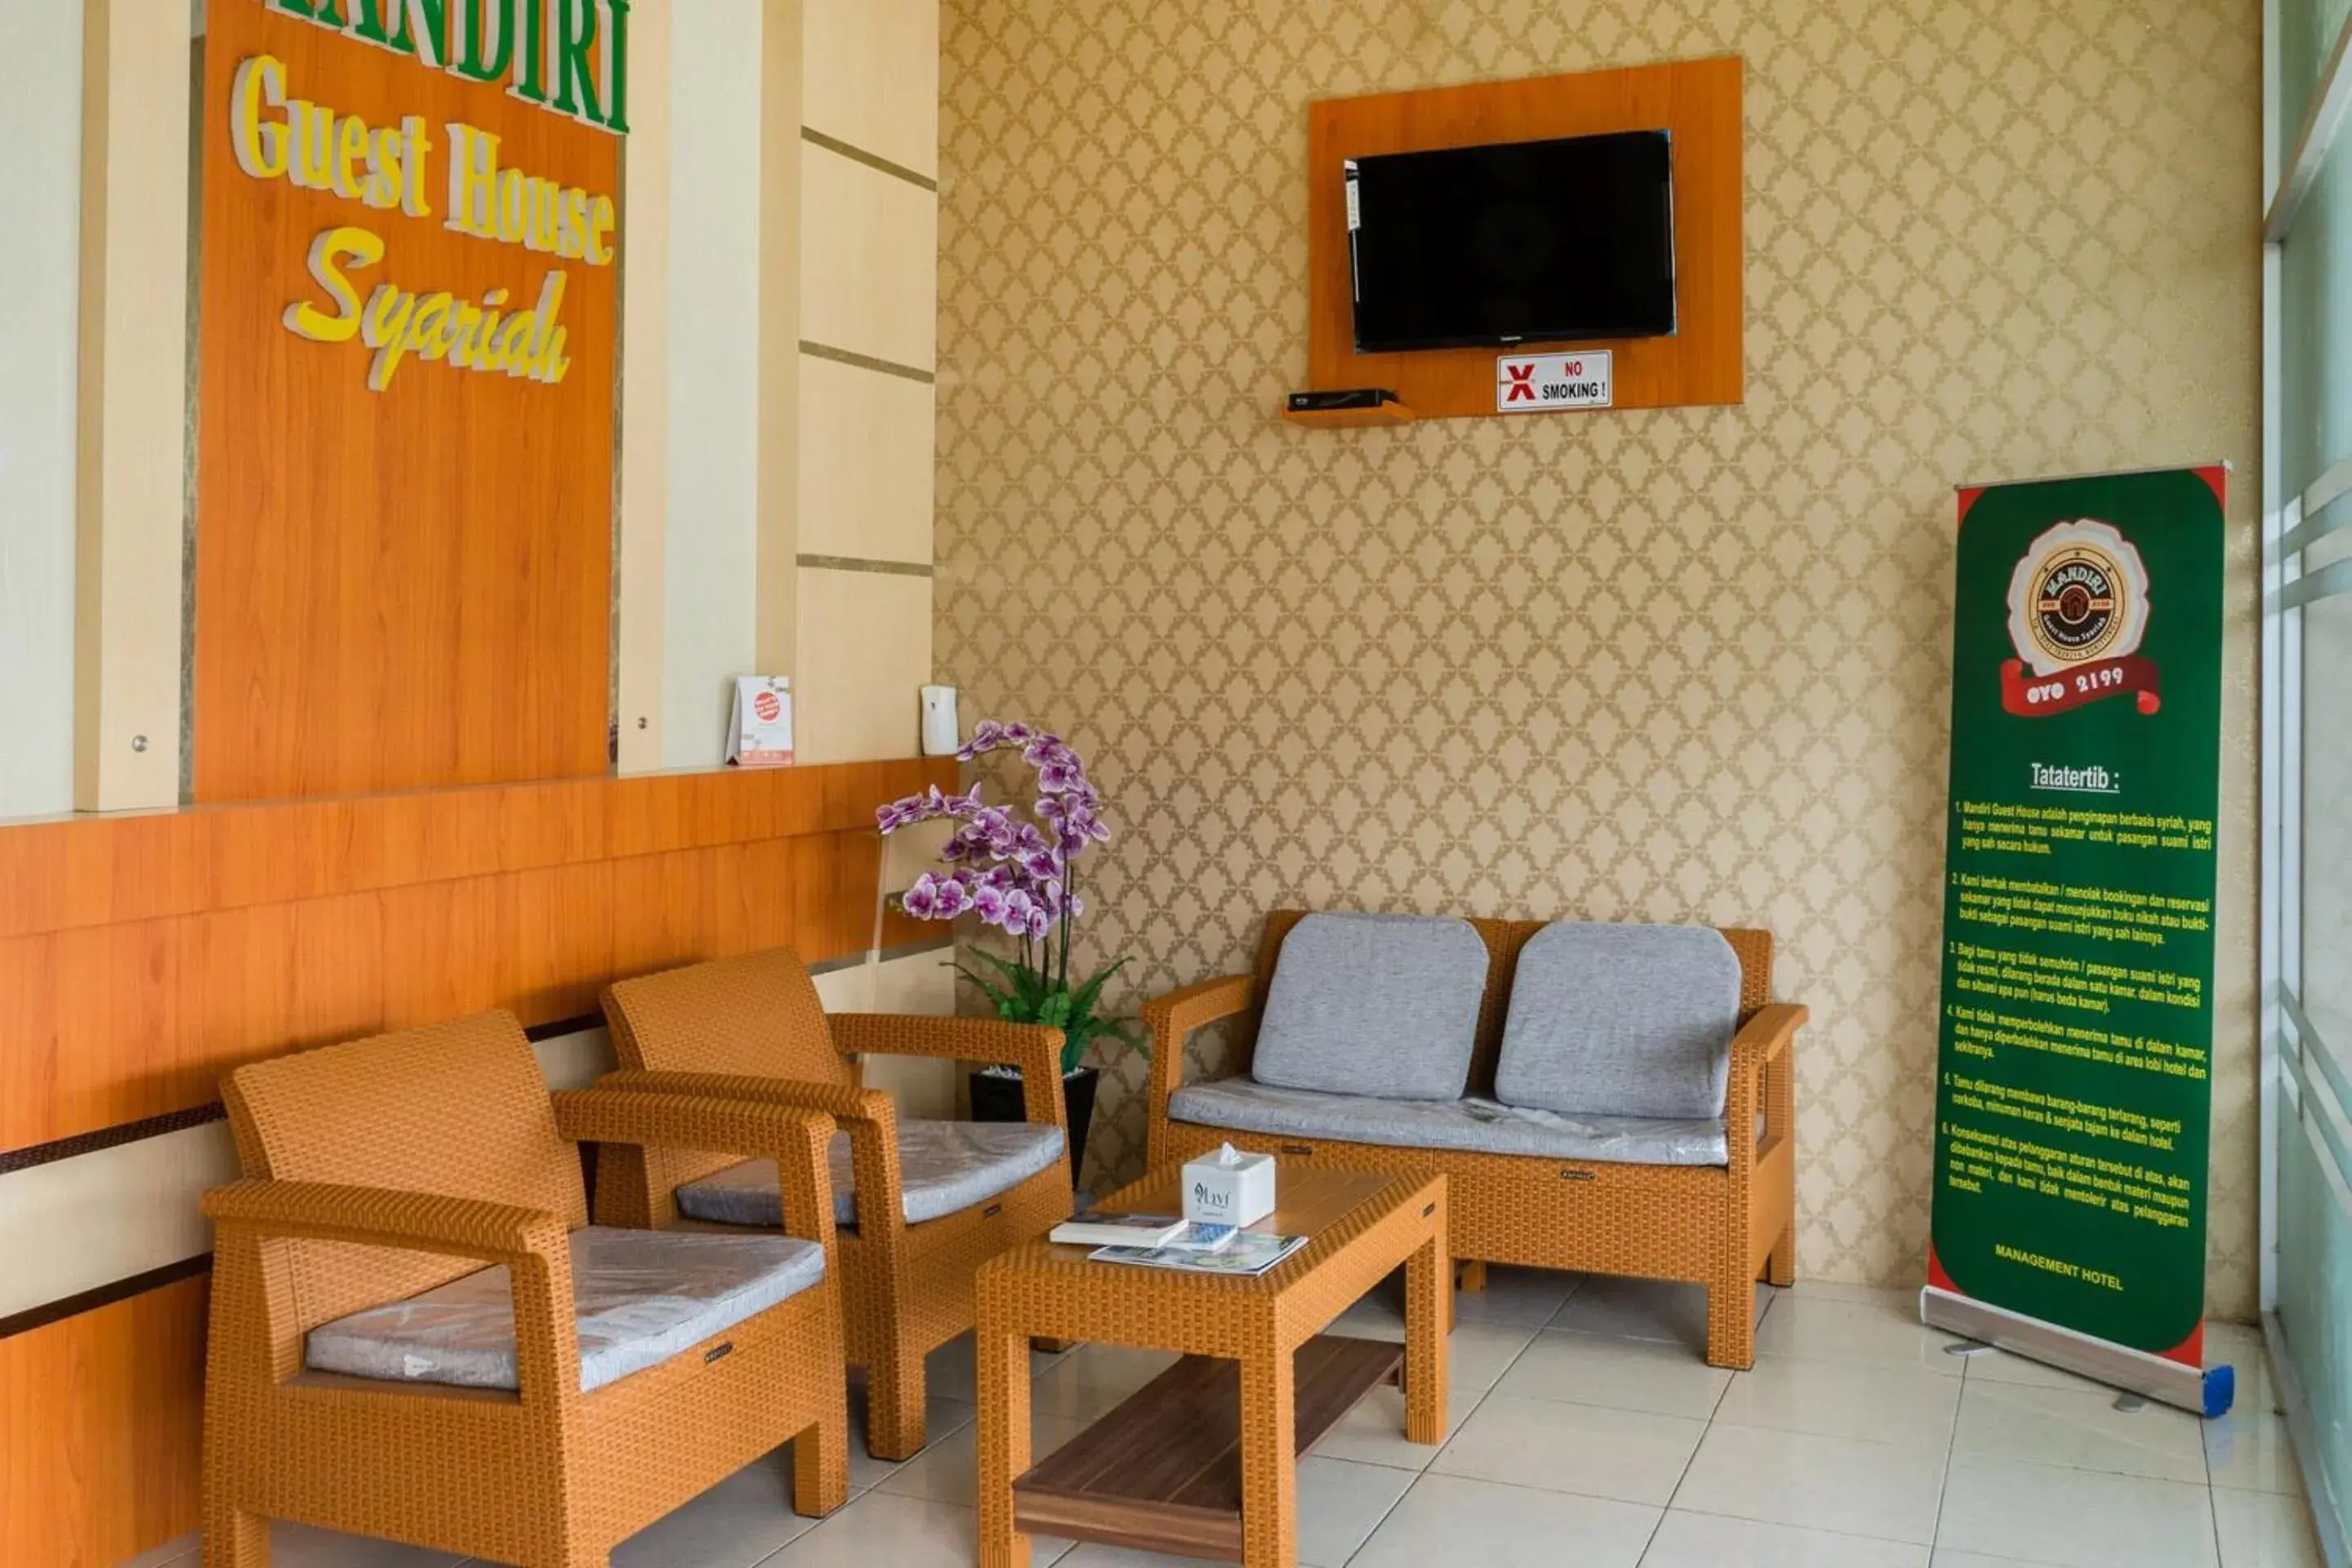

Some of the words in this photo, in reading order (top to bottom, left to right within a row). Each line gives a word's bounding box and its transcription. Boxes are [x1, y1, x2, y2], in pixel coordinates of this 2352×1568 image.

[231, 55, 431, 217] Guest
[443, 122, 614, 265] House
[283, 225, 571, 392] Syariah
[1564, 361, 1583, 377] NO
[1542, 382, 1598, 400] SMOKING
[2045, 567, 2107, 597] MANDIRI
[2027, 682, 2065, 703] OYO
[2076, 668, 2123, 693] 2199
[2031, 763, 2109, 789] Tatatertib
[1995, 1243, 2079, 1278] MANAGEMENT
[2082, 1268, 2123, 1291] HOTEL
